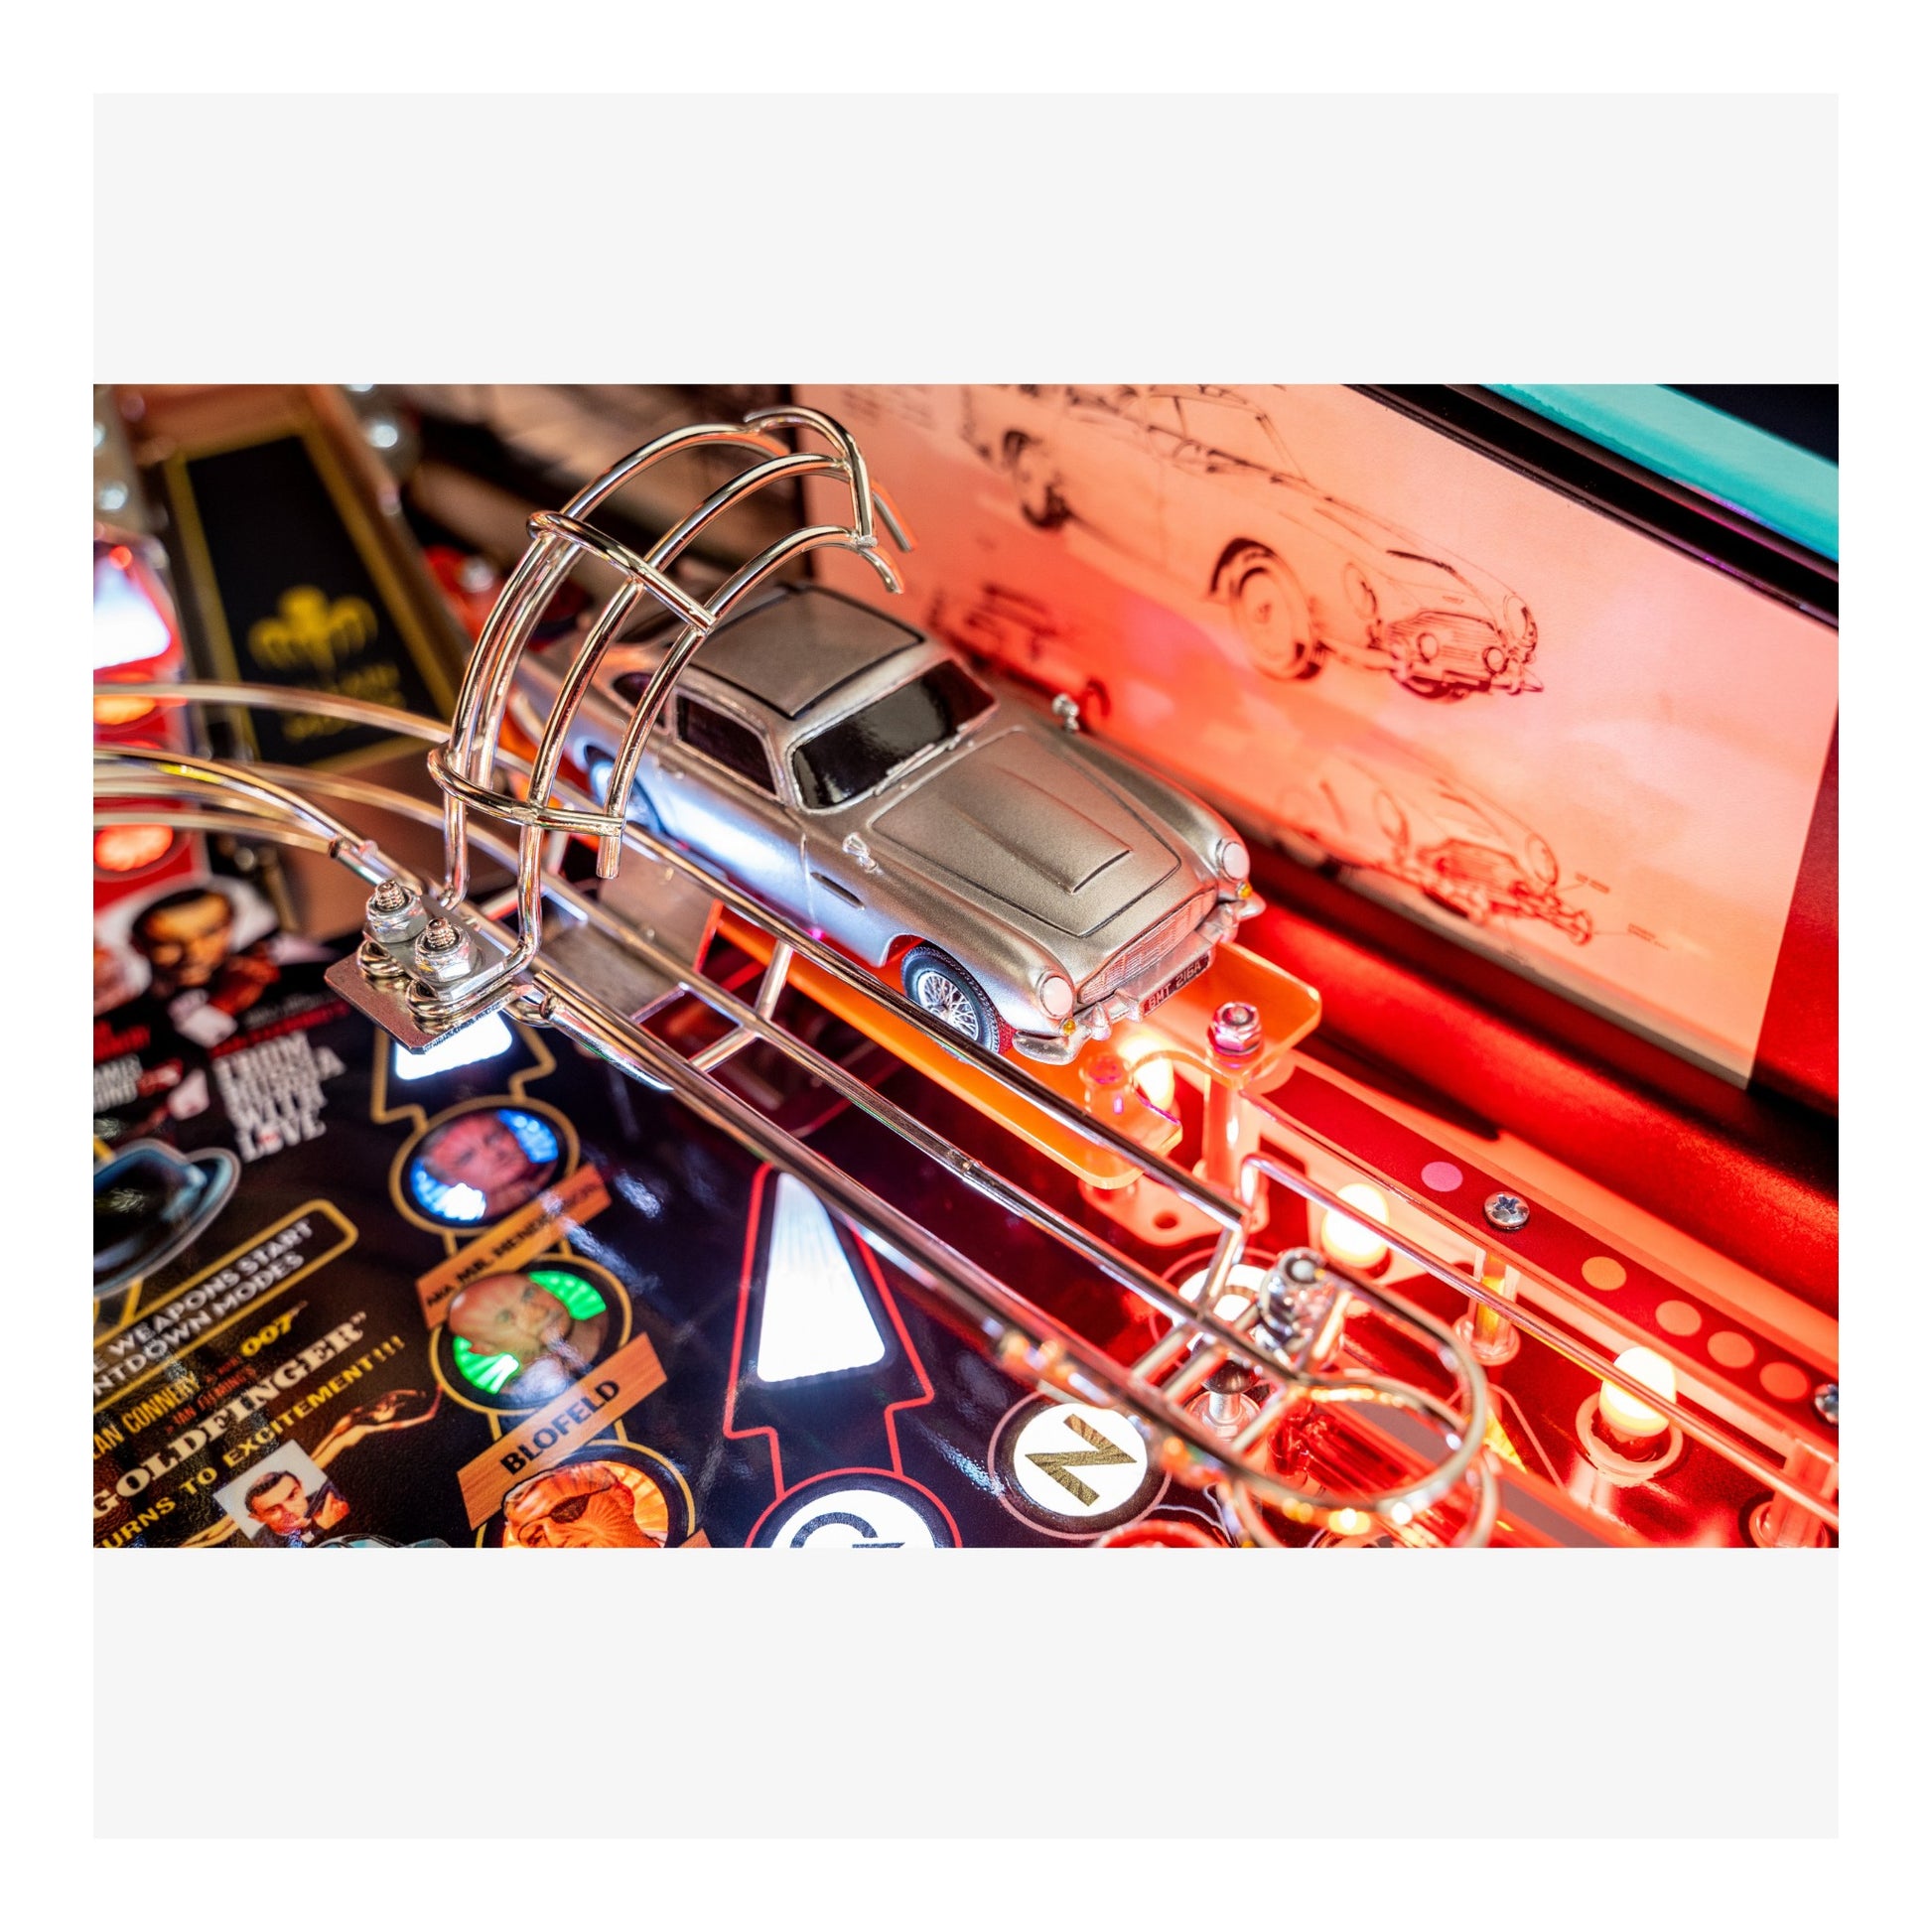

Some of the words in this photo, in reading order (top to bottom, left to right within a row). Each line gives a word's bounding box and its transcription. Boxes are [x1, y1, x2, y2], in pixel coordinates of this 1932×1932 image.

[1149, 984, 1172, 1008] BMT
[108, 1268, 240, 1357] WEAPONS
[236, 1217, 313, 1277] START
[211, 1250, 305, 1317] MODES
[121, 1370, 202, 1435] CONNERY
[240, 1311, 296, 1357] 007
[178, 1466, 217, 1495] TO
[221, 1334, 406, 1468] EXCITEMENT!!!
[499, 1379, 621, 1476] BLOFELD
[1024, 1413, 1138, 1507] N
